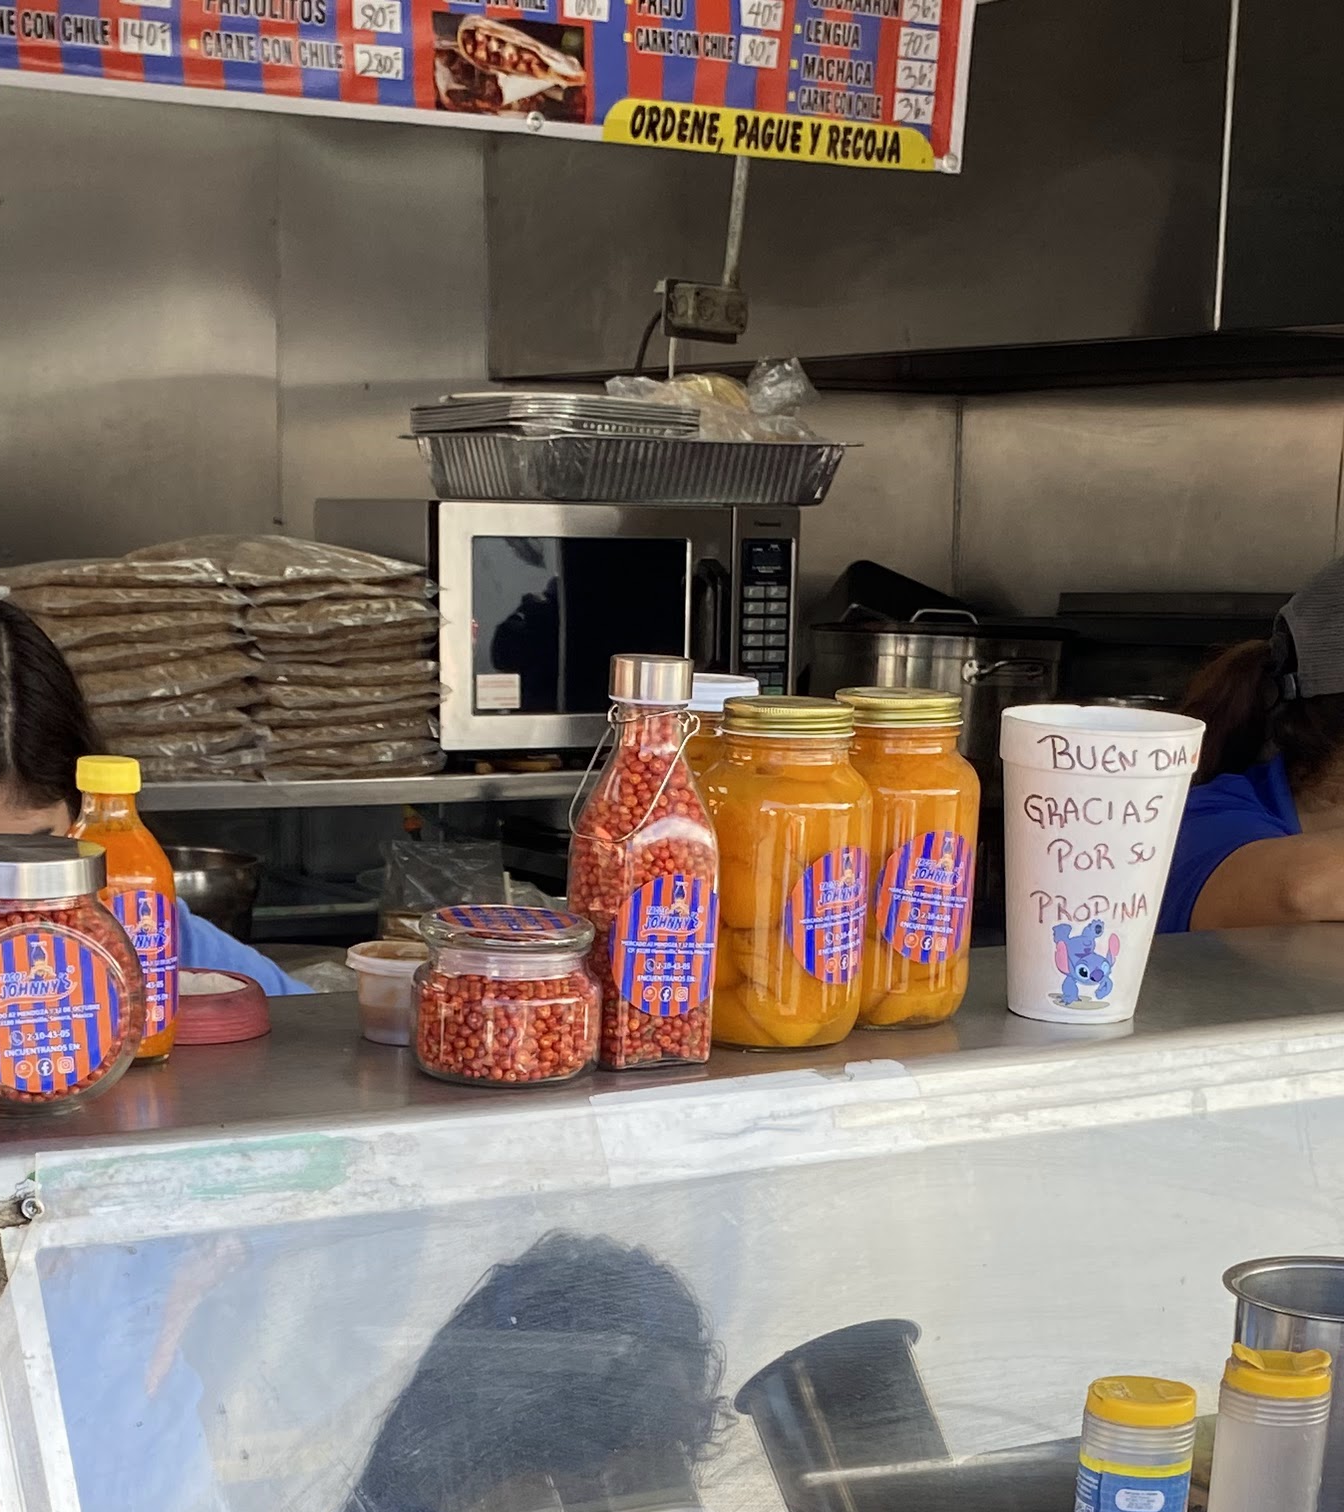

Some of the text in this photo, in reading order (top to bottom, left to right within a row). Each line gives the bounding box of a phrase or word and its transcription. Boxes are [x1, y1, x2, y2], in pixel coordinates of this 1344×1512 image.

[811, 0, 899, 17] HARRON
[21, 11, 56, 40] CON
[62, 15, 111, 46] CHILE
[637, 27, 735, 60] CARNE CON CHILE
[806, 19, 861, 48] LENGUA
[203, 31, 344, 69] CARNE CON CHILE
[802, 55, 873, 86] MACHACA
[799, 87, 882, 119] CARNE CON CHILE
[630, 105, 901, 163] ORDENE, PAGUE Y RECOJA
[1037, 734, 1188, 774] BUEN DIA
[1023, 794, 1164, 829] GRACIAS
[1047, 838, 1156, 873] POR SU
[0, 973, 74, 1000] JOHNNY'S
